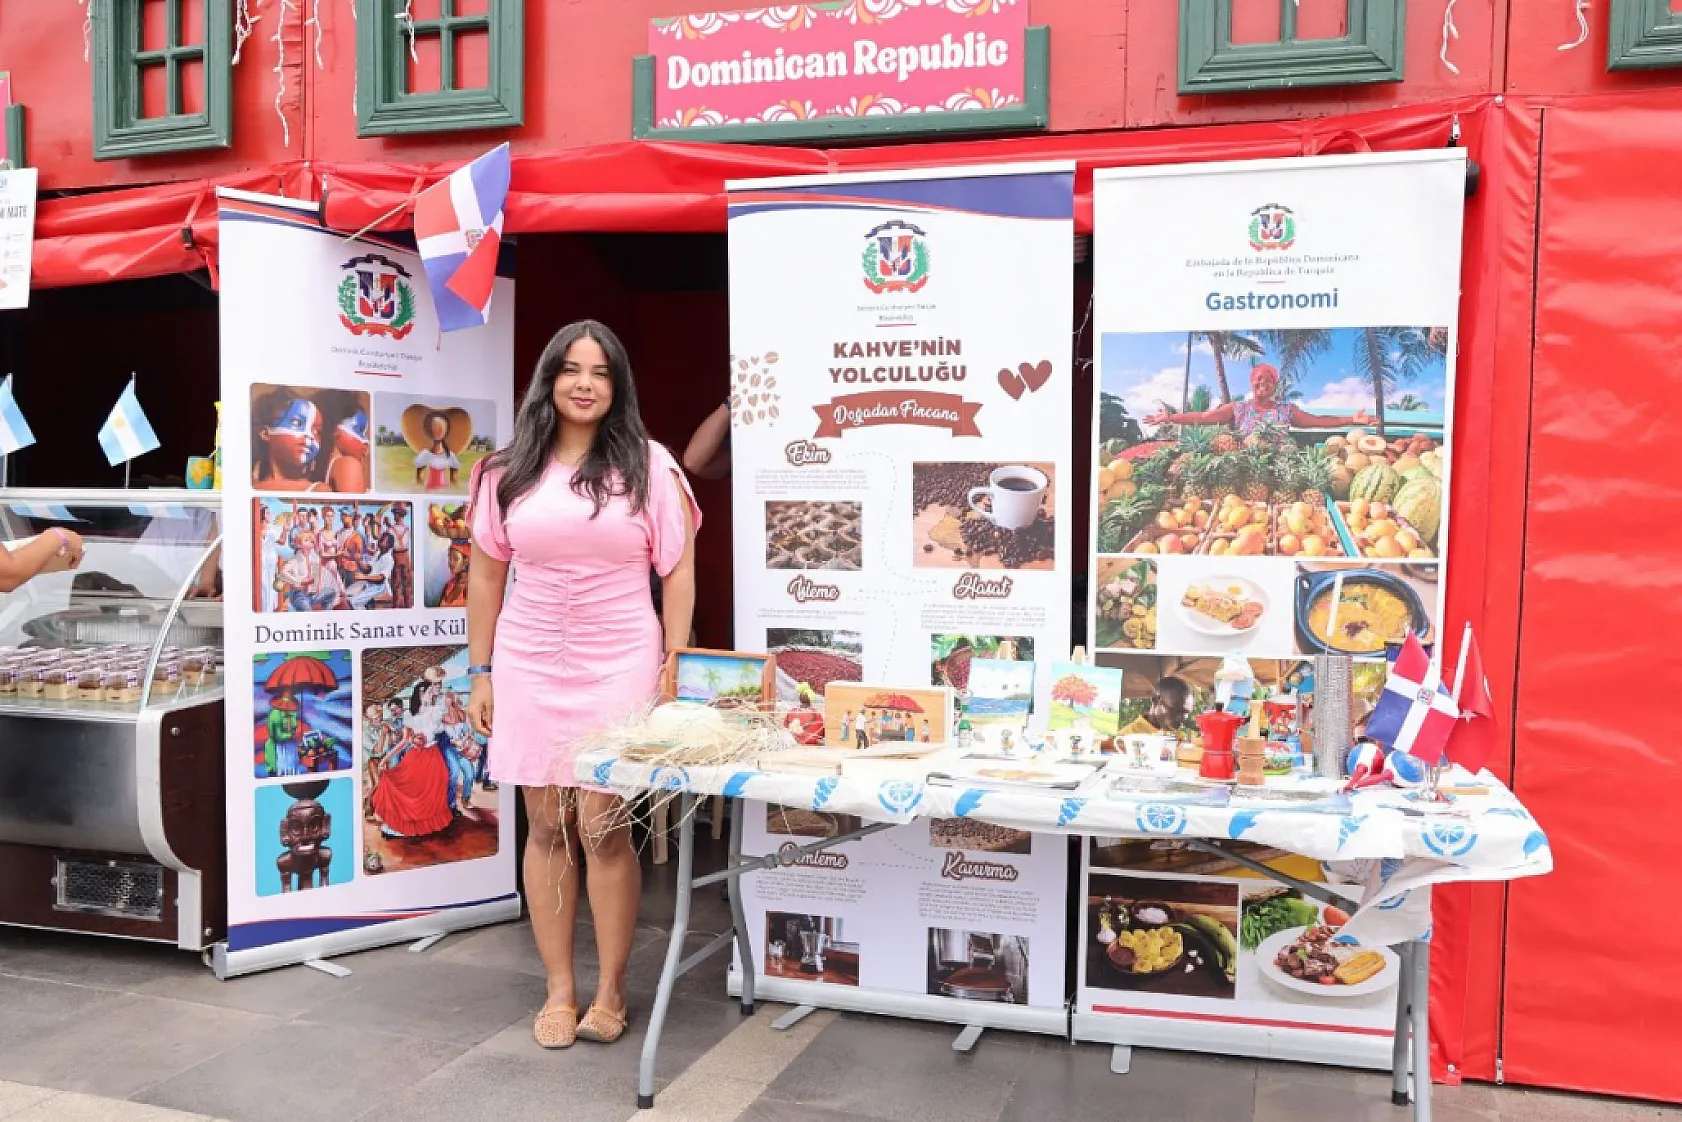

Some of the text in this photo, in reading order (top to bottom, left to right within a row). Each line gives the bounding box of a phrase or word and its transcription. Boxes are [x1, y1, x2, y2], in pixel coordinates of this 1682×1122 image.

[667, 31, 1009, 90] Dominican Republic
[1303, 253, 1361, 264] Dominicana
[1205, 287, 1340, 311] Gastronomi
[833, 336, 962, 359] KAHVE'NİN
[828, 361, 967, 383] YOLCULUĞU
[900, 399, 960, 421] Fincana
[785, 440, 831, 466] Ekim
[953, 572, 1013, 600] Hasat
[254, 622, 345, 644] Dominik
[350, 621, 405, 640] Sanat
[408, 623, 430, 638] ve
[942, 851, 1018, 881] Kavurma
